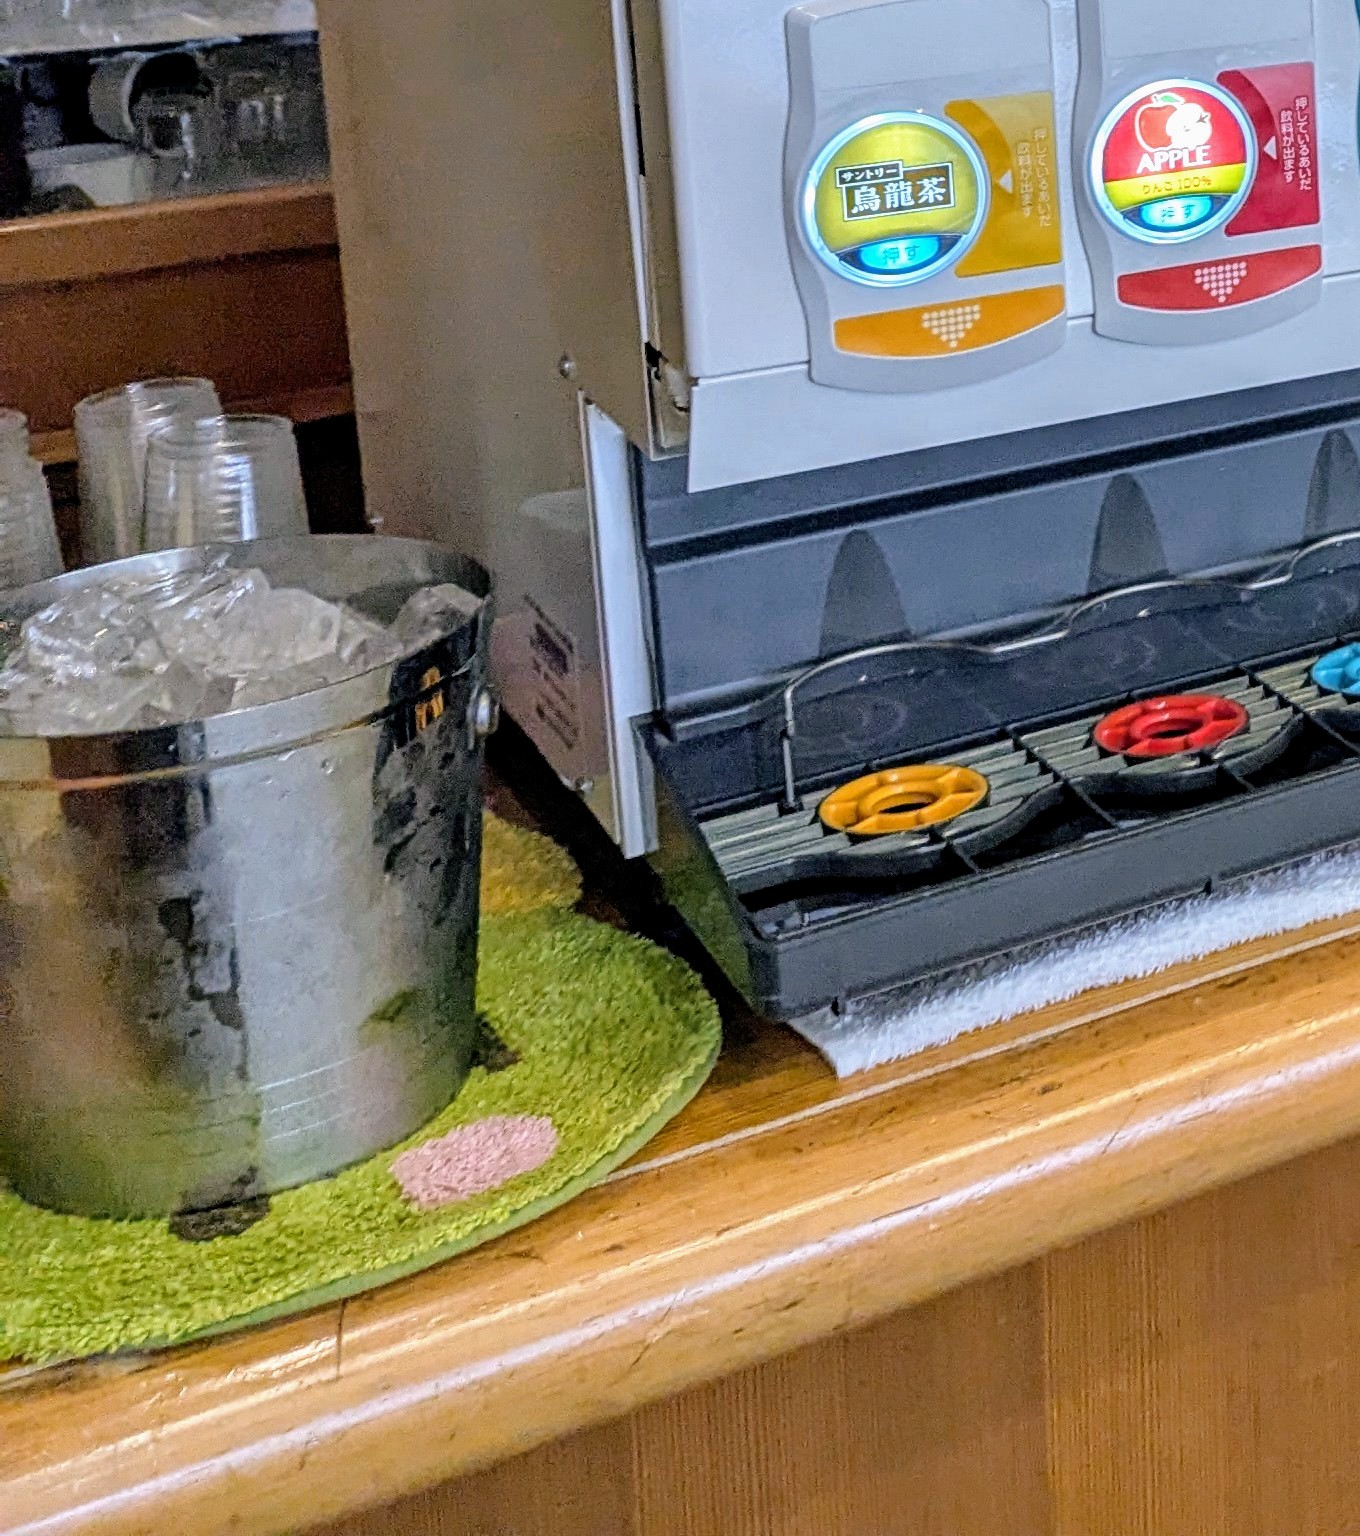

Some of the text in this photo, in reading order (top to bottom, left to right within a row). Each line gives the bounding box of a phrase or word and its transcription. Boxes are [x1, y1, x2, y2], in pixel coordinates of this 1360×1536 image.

[1280, 110, 1295, 183] 飲料が出ます
[1295, 96, 1312, 191] 押しているあいだ
[840, 167, 899, 181] サントリー
[1137, 145, 1212, 174] APPLE
[851, 177, 946, 214] 烏龍茶
[1178, 176, 1212, 190] 100%
[883, 244, 920, 264] 押す
